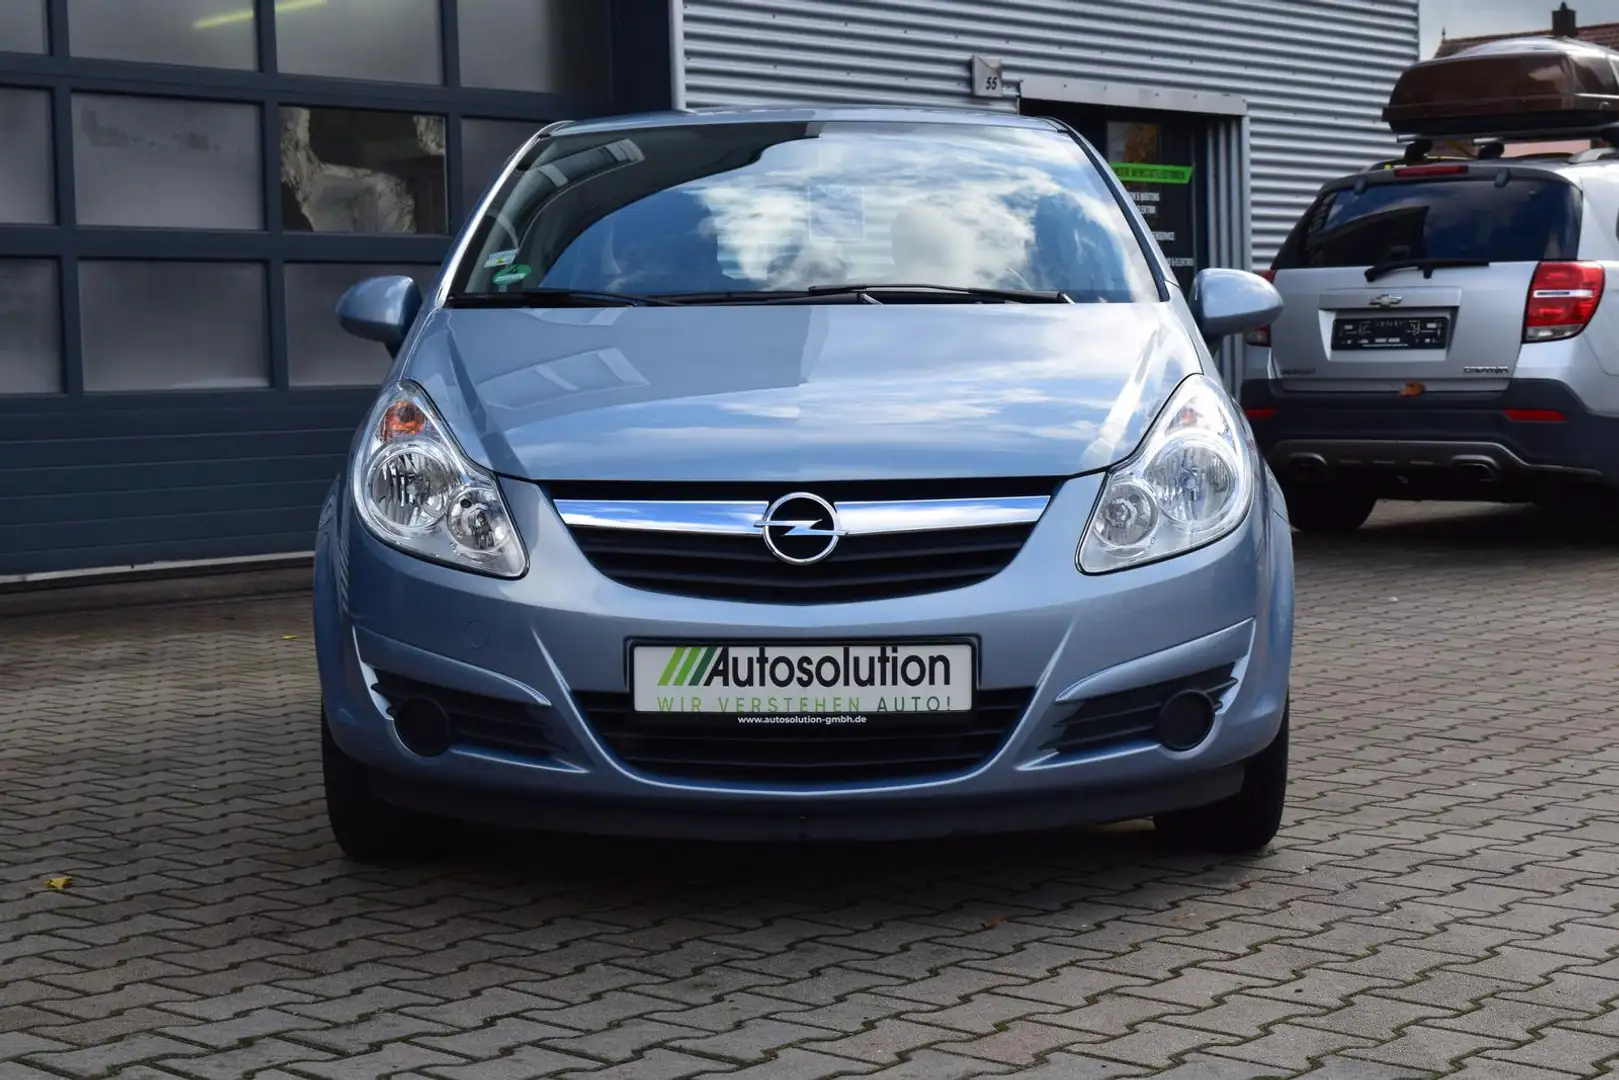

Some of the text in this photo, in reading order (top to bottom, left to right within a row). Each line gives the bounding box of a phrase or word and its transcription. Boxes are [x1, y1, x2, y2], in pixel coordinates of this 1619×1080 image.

[986, 77, 997, 90] 55
[703, 646, 951, 687] Autosolution
[657, 696, 951, 712] WIR VERSTEHEN AUTO!
[738, 715, 867, 725] www.autosolution-gmbh.de
